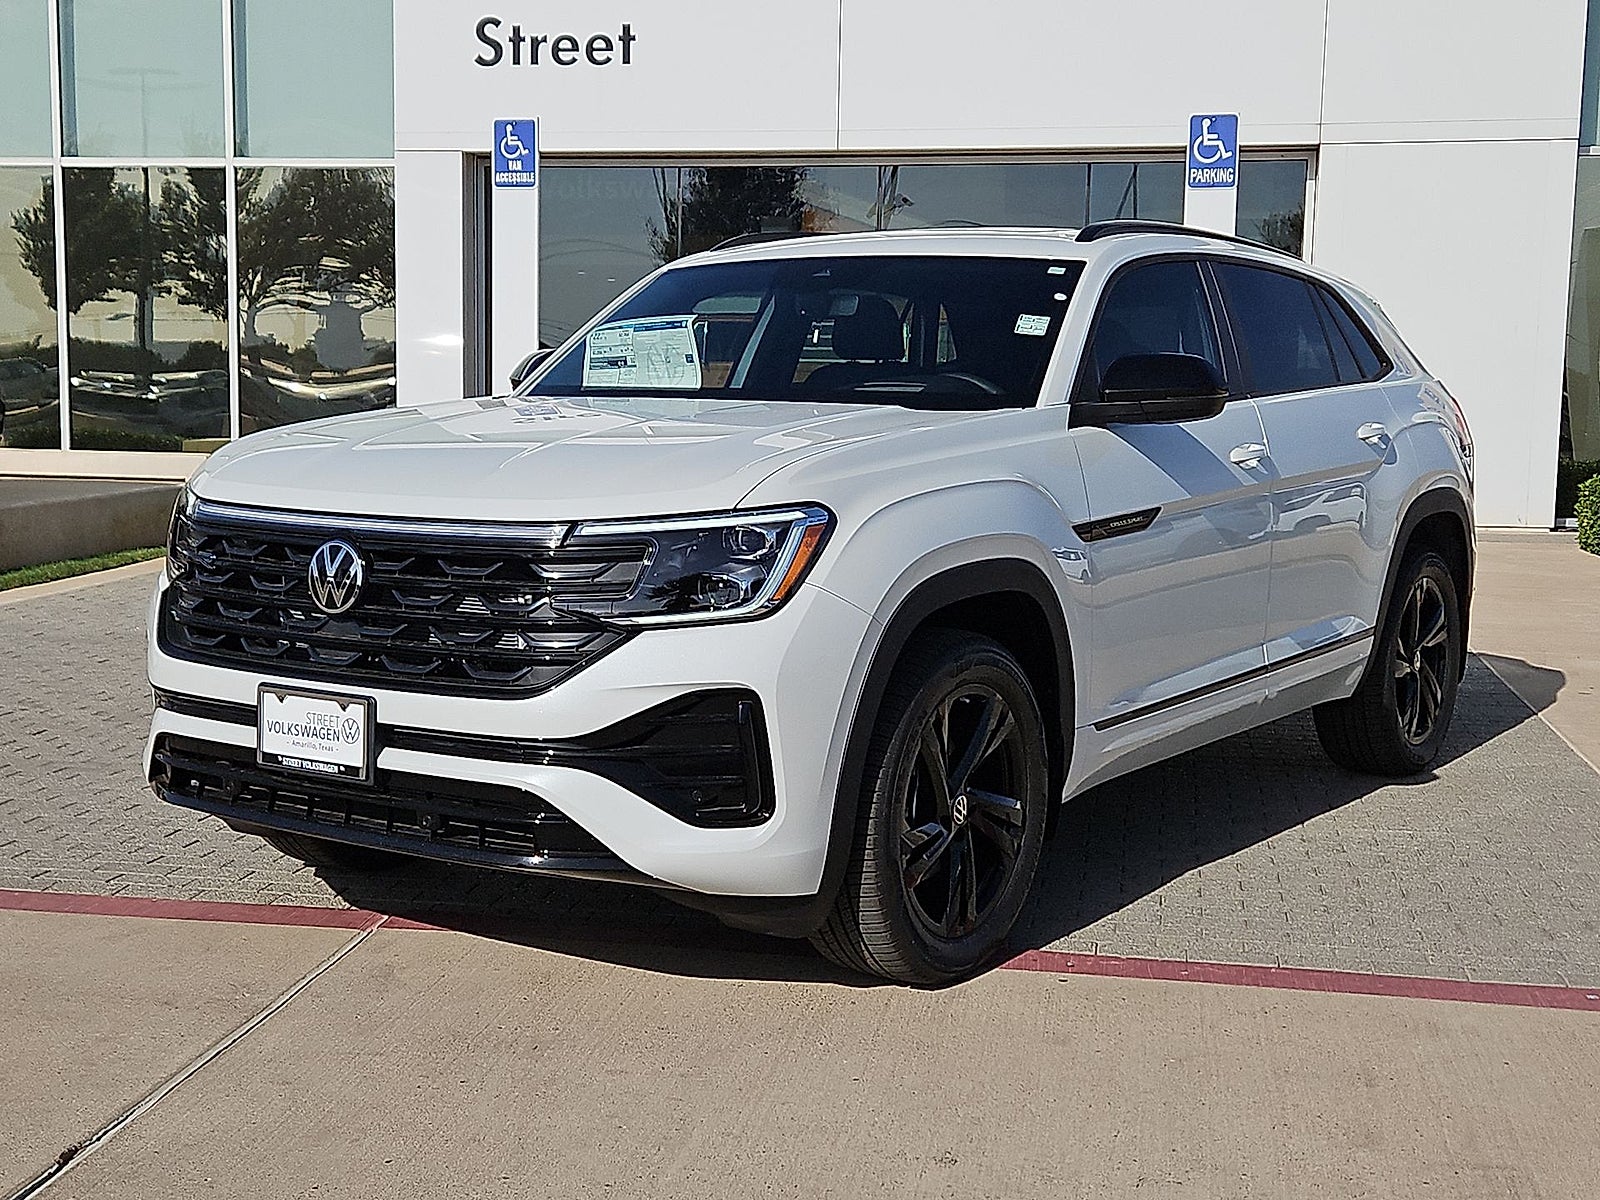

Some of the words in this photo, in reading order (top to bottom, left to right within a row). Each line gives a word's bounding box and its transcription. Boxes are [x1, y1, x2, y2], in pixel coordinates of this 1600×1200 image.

[474, 16, 636, 67] Street
[507, 159, 523, 172] VAN
[495, 172, 535, 184] ACCESSIBLE
[1190, 168, 1234, 183] PARKING
[305, 711, 340, 728] STREET
[266, 719, 340, 742] VOLKSWAGEN
